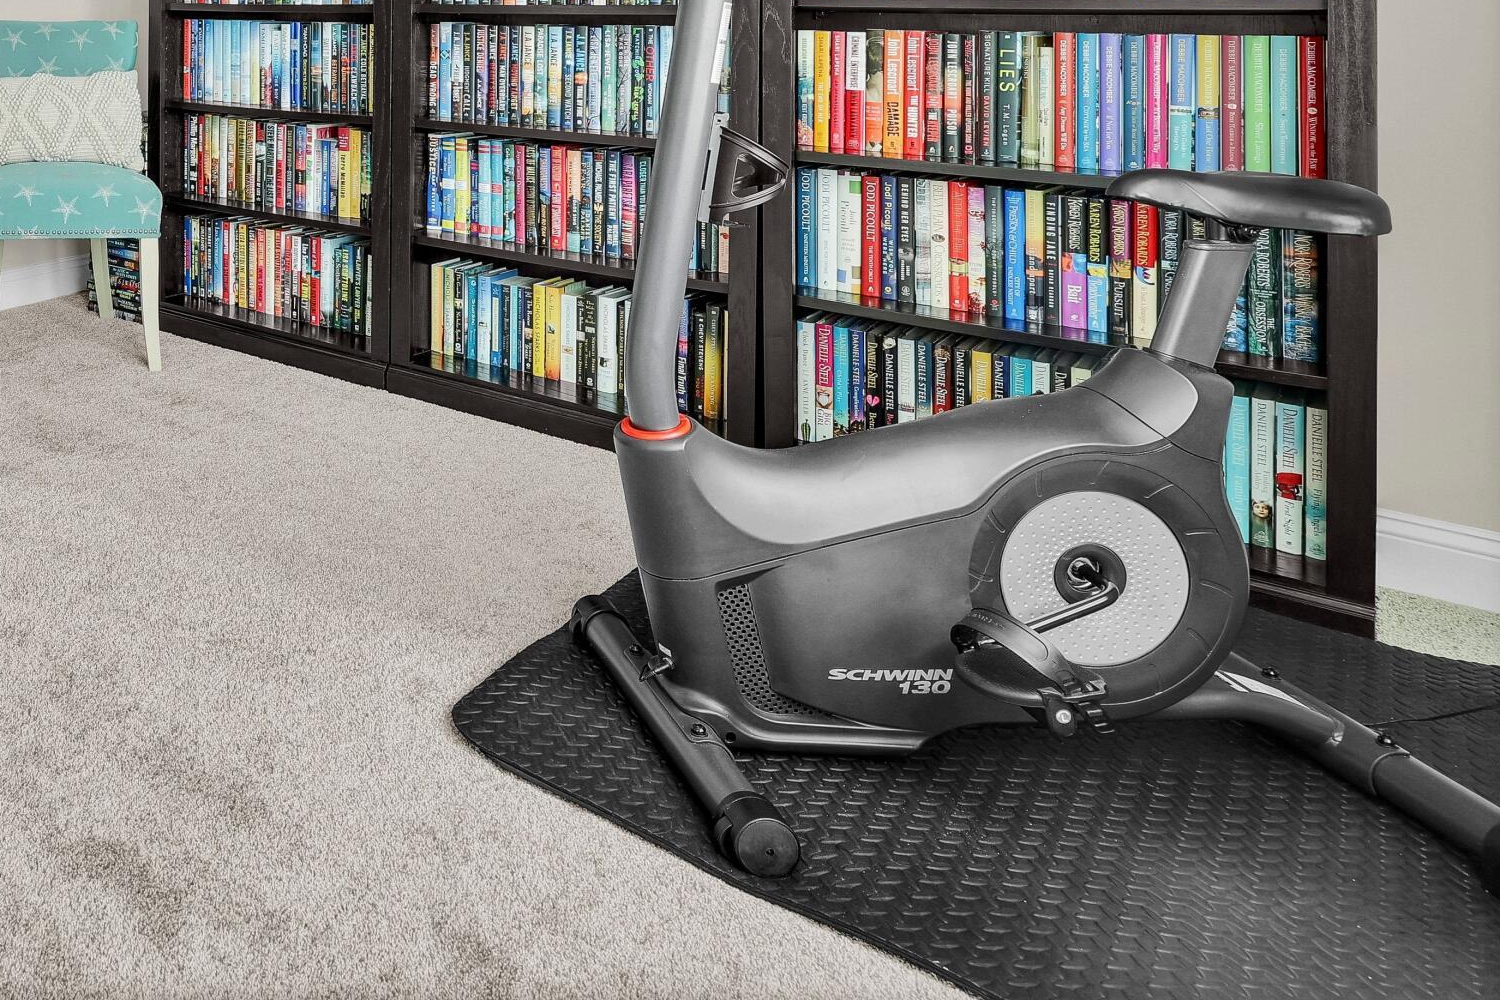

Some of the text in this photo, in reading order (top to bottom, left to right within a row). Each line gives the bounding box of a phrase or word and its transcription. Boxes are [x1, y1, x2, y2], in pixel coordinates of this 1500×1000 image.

[644, 46, 655, 82] OTHER
[887, 38, 899, 56] John
[947, 40, 957, 59] JOHN
[1308, 42, 1316, 65] DEBBIE
[999, 49, 1015, 92] LIES
[1308, 66, 1316, 104] MACOMBER
[887, 102, 899, 137] DAMAGE
[947, 109, 956, 135] POISON
[608, 172, 616, 191] FIRST
[608, 192, 616, 220] PATIENT
[865, 181, 875, 242] JODI PICOULT
[884, 182, 892, 231] Jodi Picoult
[901, 184, 909, 242] BEHIND HER EYES
[1046, 202, 1056, 260] FINDING JAKE
[1113, 205, 1126, 318] KAREN ROBARDS PURSUIT
[677, 356, 687, 395] Final Truth
[885, 354, 893, 389] DANIELLE
[956, 351, 964, 408] DANIELLE STEEL
[1311, 413, 1323, 536] DANIELLE STEEL Flying Angels
[828, 668, 954, 681] SCHWINN
[899, 680, 951, 695] 130
